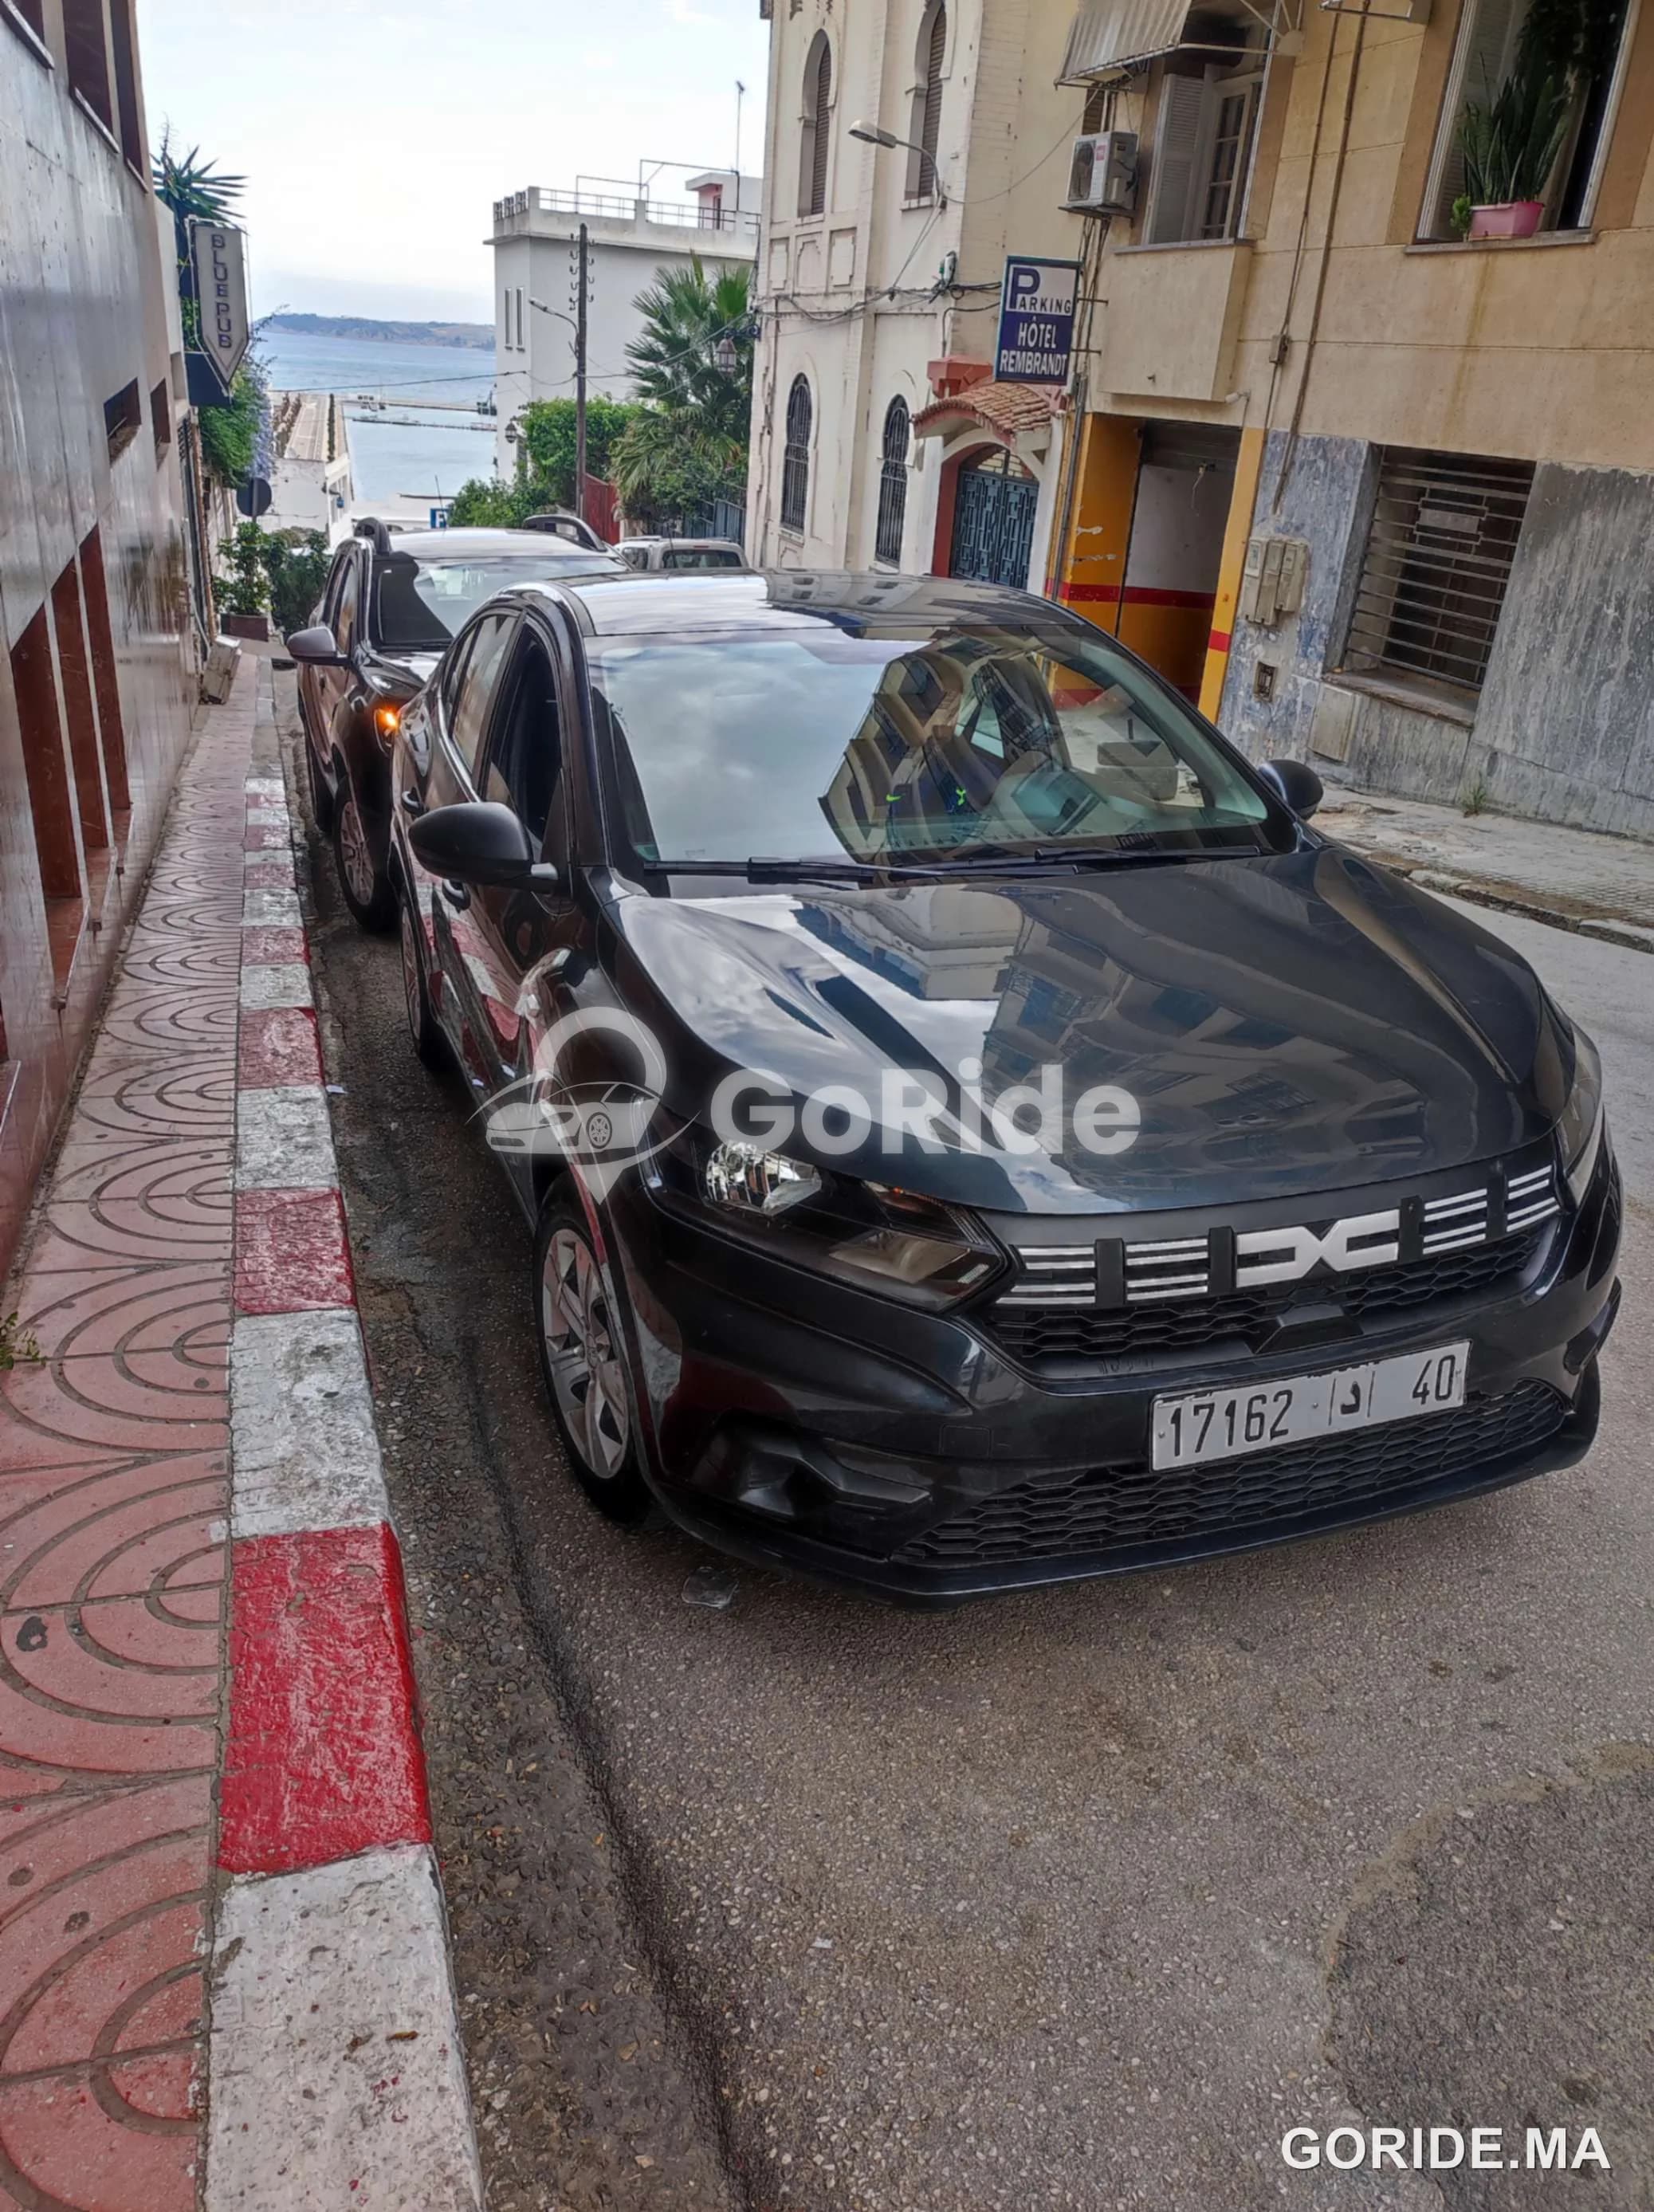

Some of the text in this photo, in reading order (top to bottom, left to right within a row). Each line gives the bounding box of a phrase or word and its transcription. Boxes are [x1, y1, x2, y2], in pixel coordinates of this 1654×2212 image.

[211, 234, 232, 348] BLUE PUB
[1008, 266, 1071, 314] PARKING
[1017, 316, 1056, 348] HÔTEL
[999, 349, 1068, 376] REMBRANDT
[1169, 1389, 1293, 1457] 17162
[1412, 1354, 1456, 1405] 40
